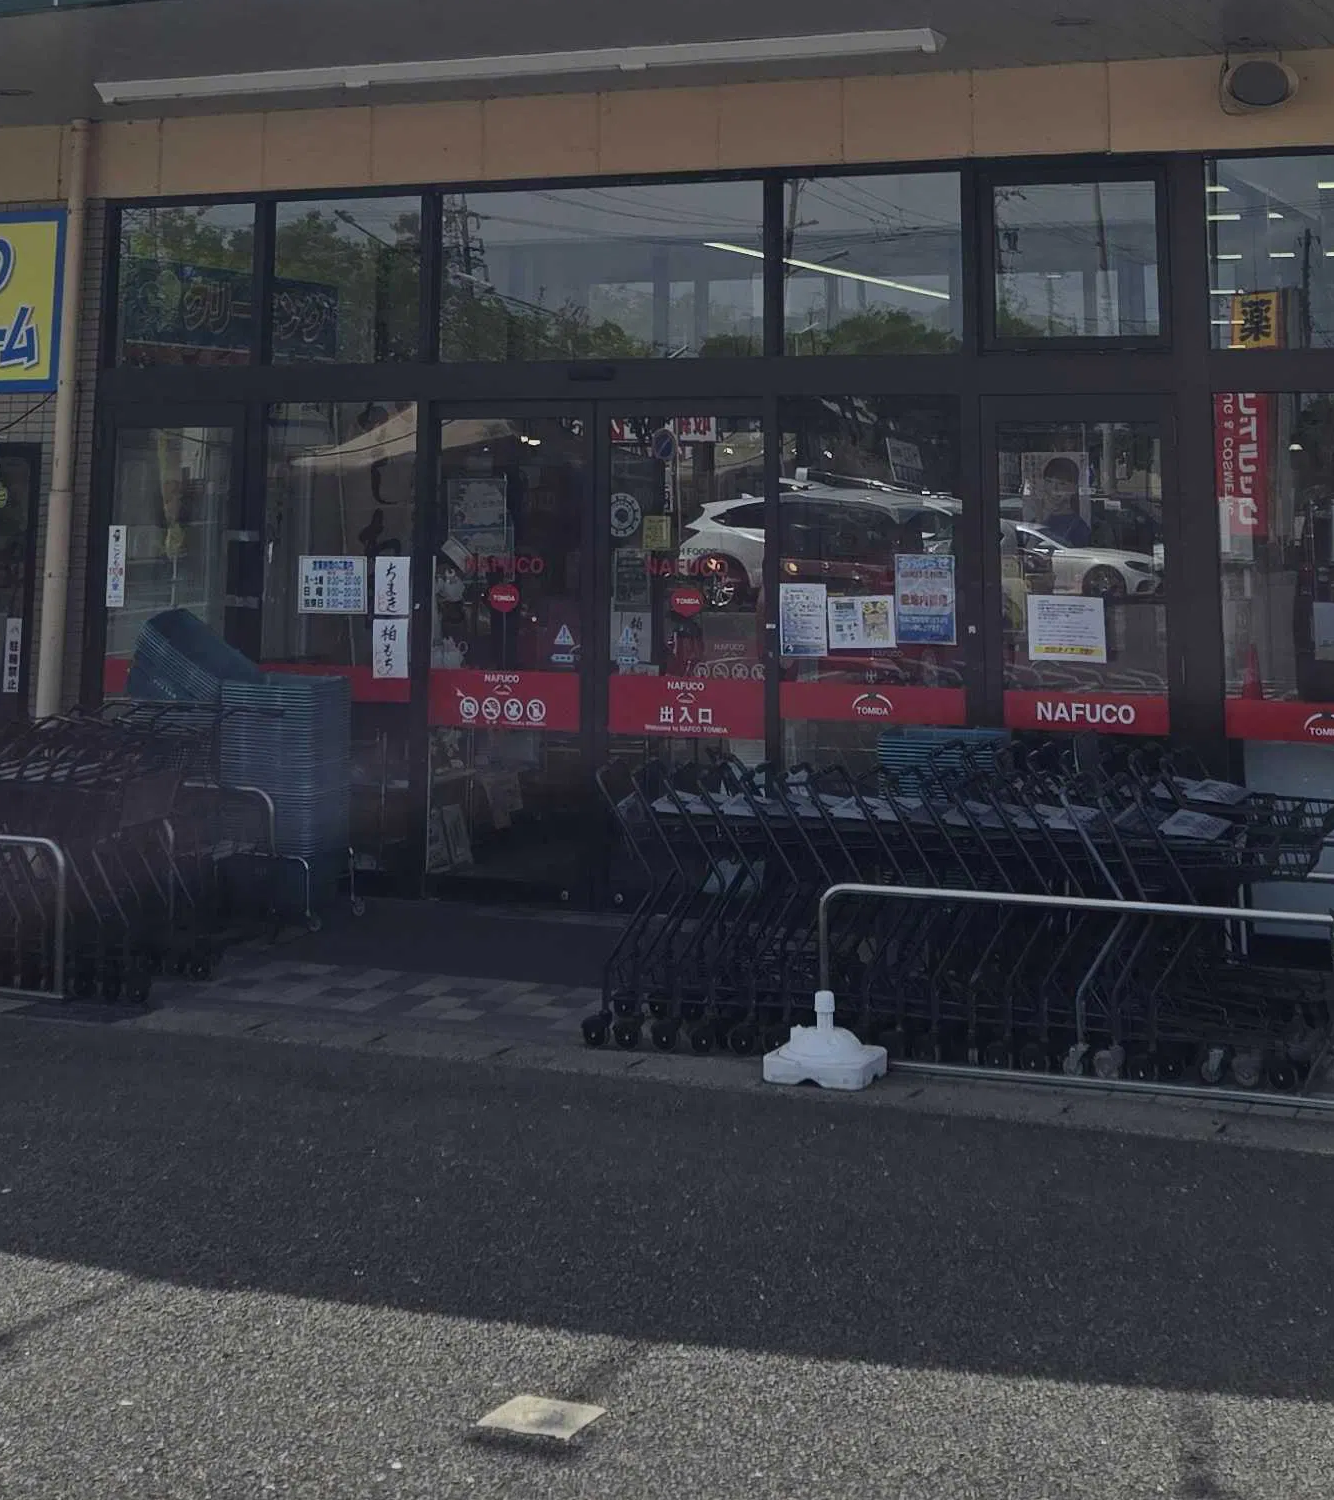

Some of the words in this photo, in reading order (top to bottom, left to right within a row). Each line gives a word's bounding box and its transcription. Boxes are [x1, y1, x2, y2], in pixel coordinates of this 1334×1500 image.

[386, 562, 398, 613] ちまき
[381, 624, 398, 676] 柏もち
[484, 674, 520, 684] NAFUCO
[667, 681, 704, 692] NAFUCO
[659, 706, 713, 724] 出入口
[856, 705, 890, 717] TOMIDA
[1036, 702, 1135, 724] NAFUCO
